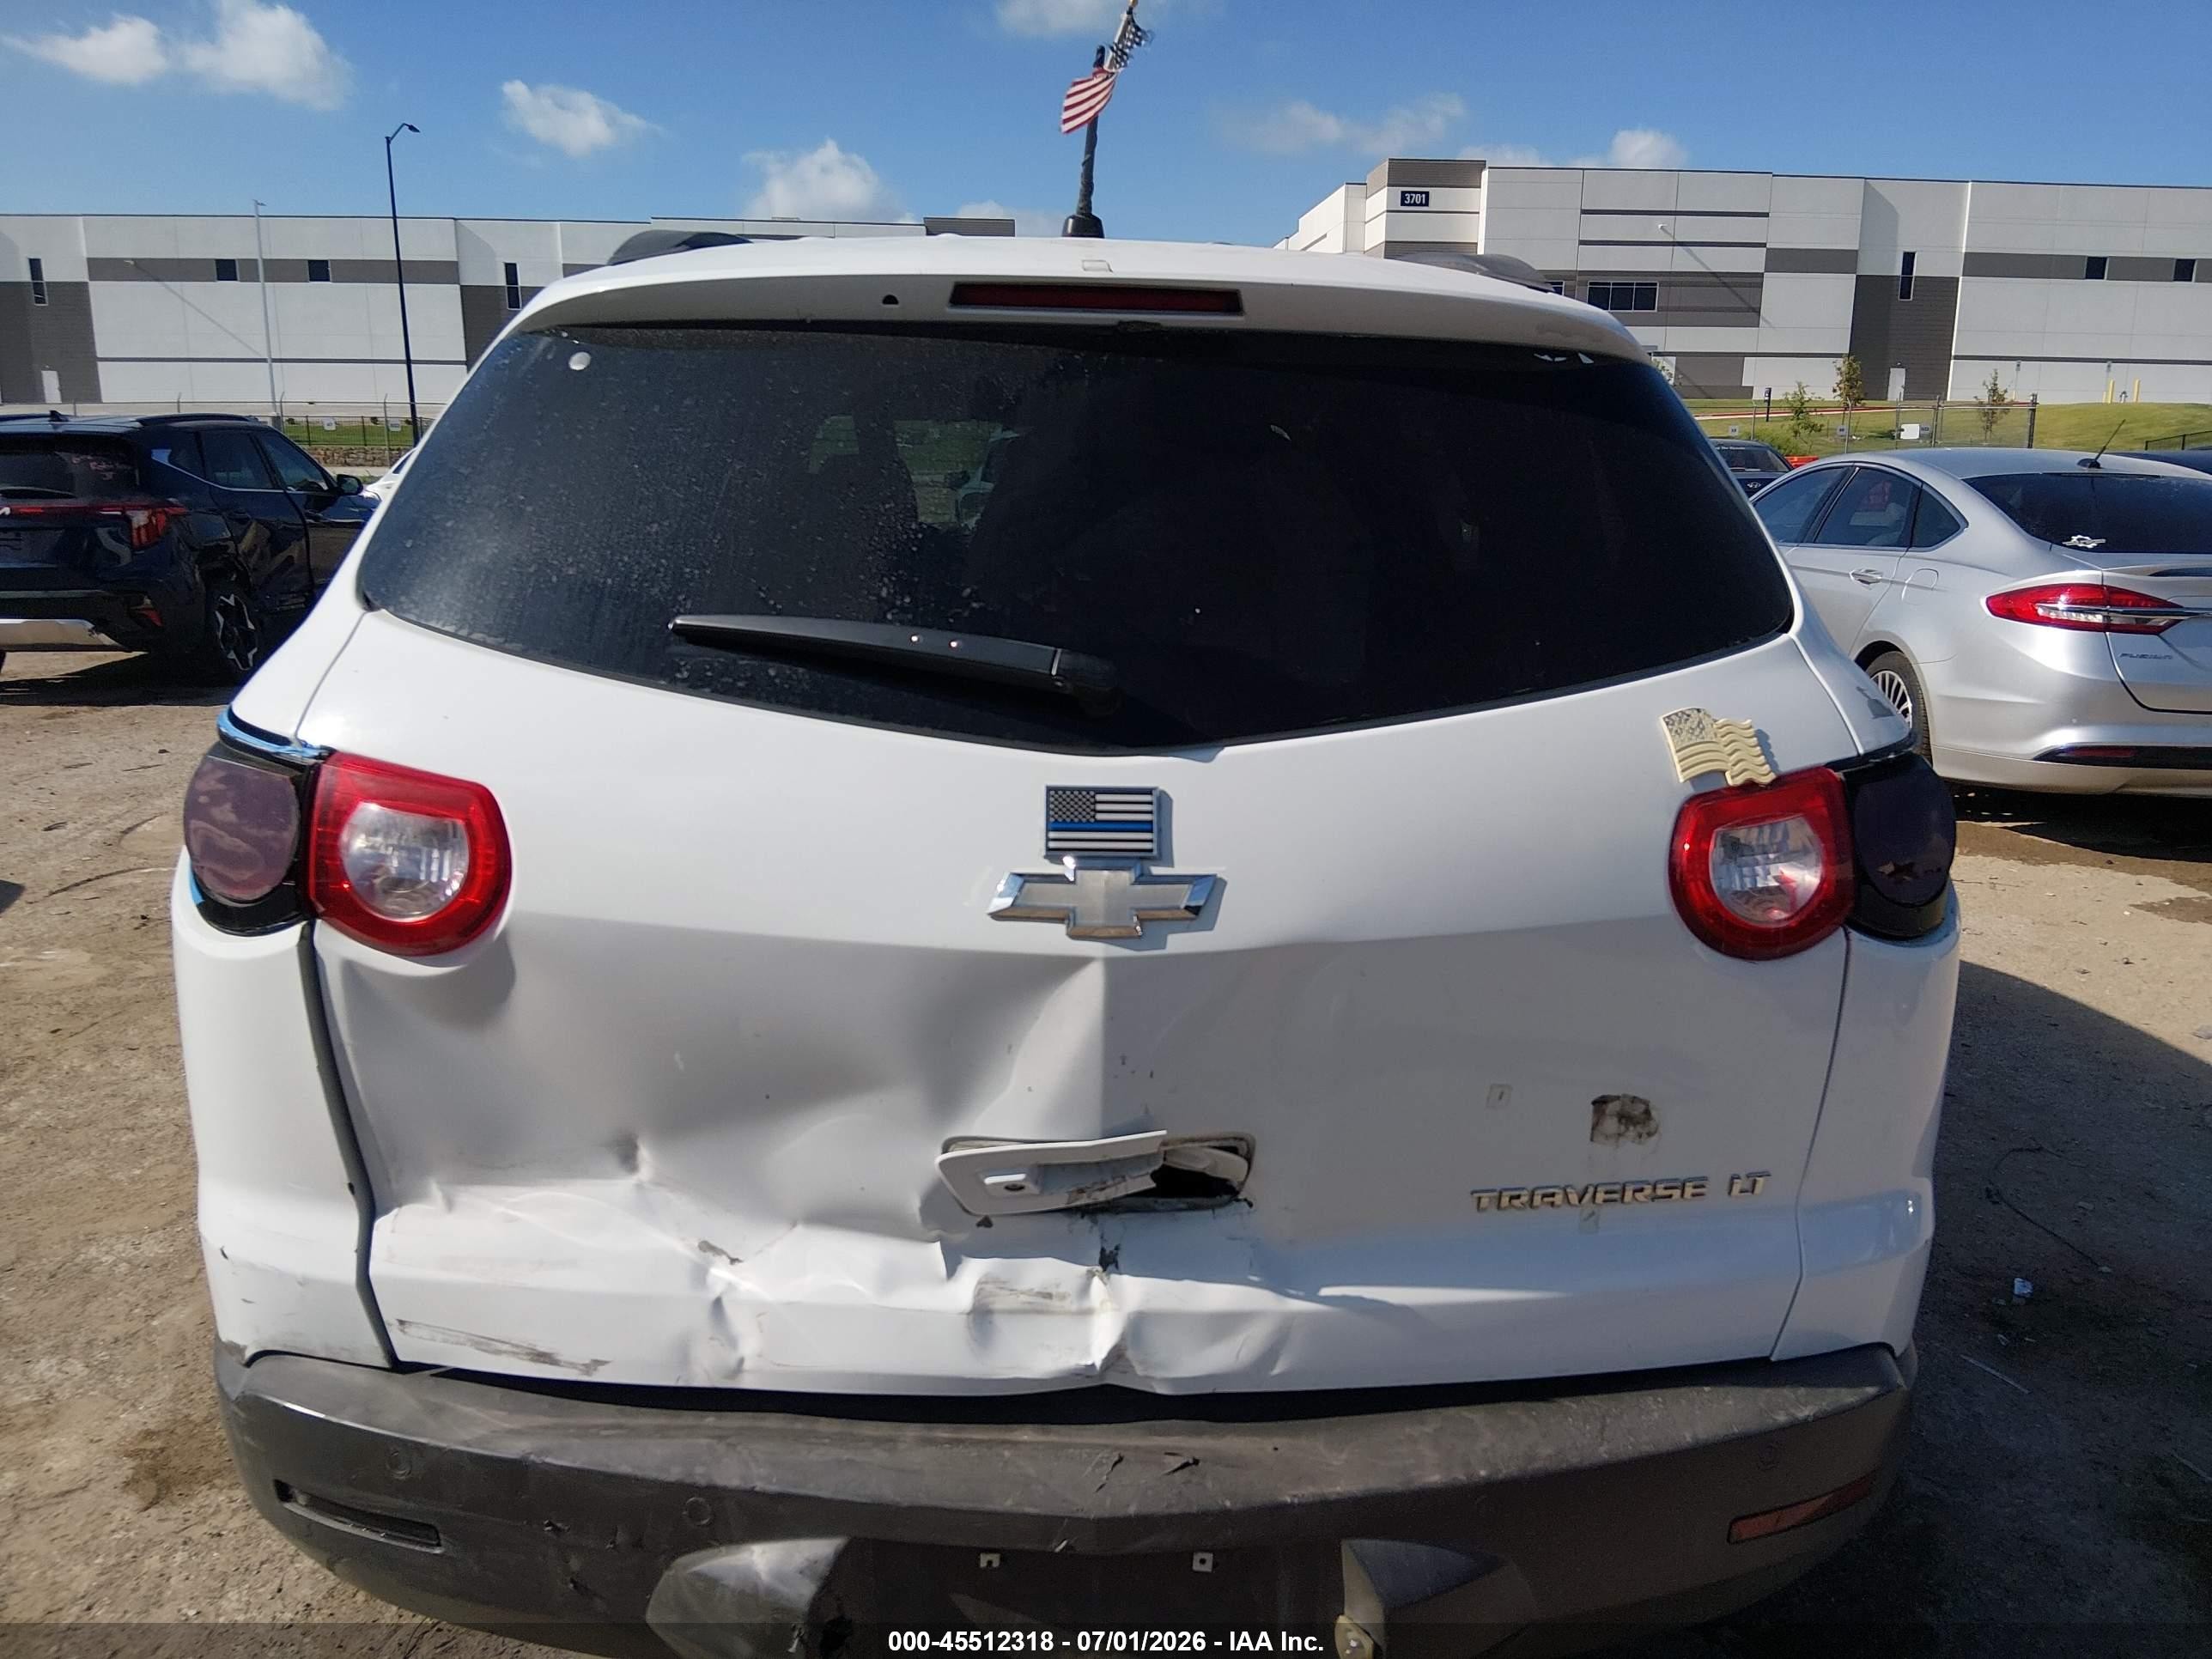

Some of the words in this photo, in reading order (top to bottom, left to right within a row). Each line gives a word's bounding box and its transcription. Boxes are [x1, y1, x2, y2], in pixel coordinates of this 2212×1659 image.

[1404, 193, 1425, 204] 3701
[1470, 1176, 1709, 1212] TRAVERSE
[1728, 1171, 1771, 1197] LT
